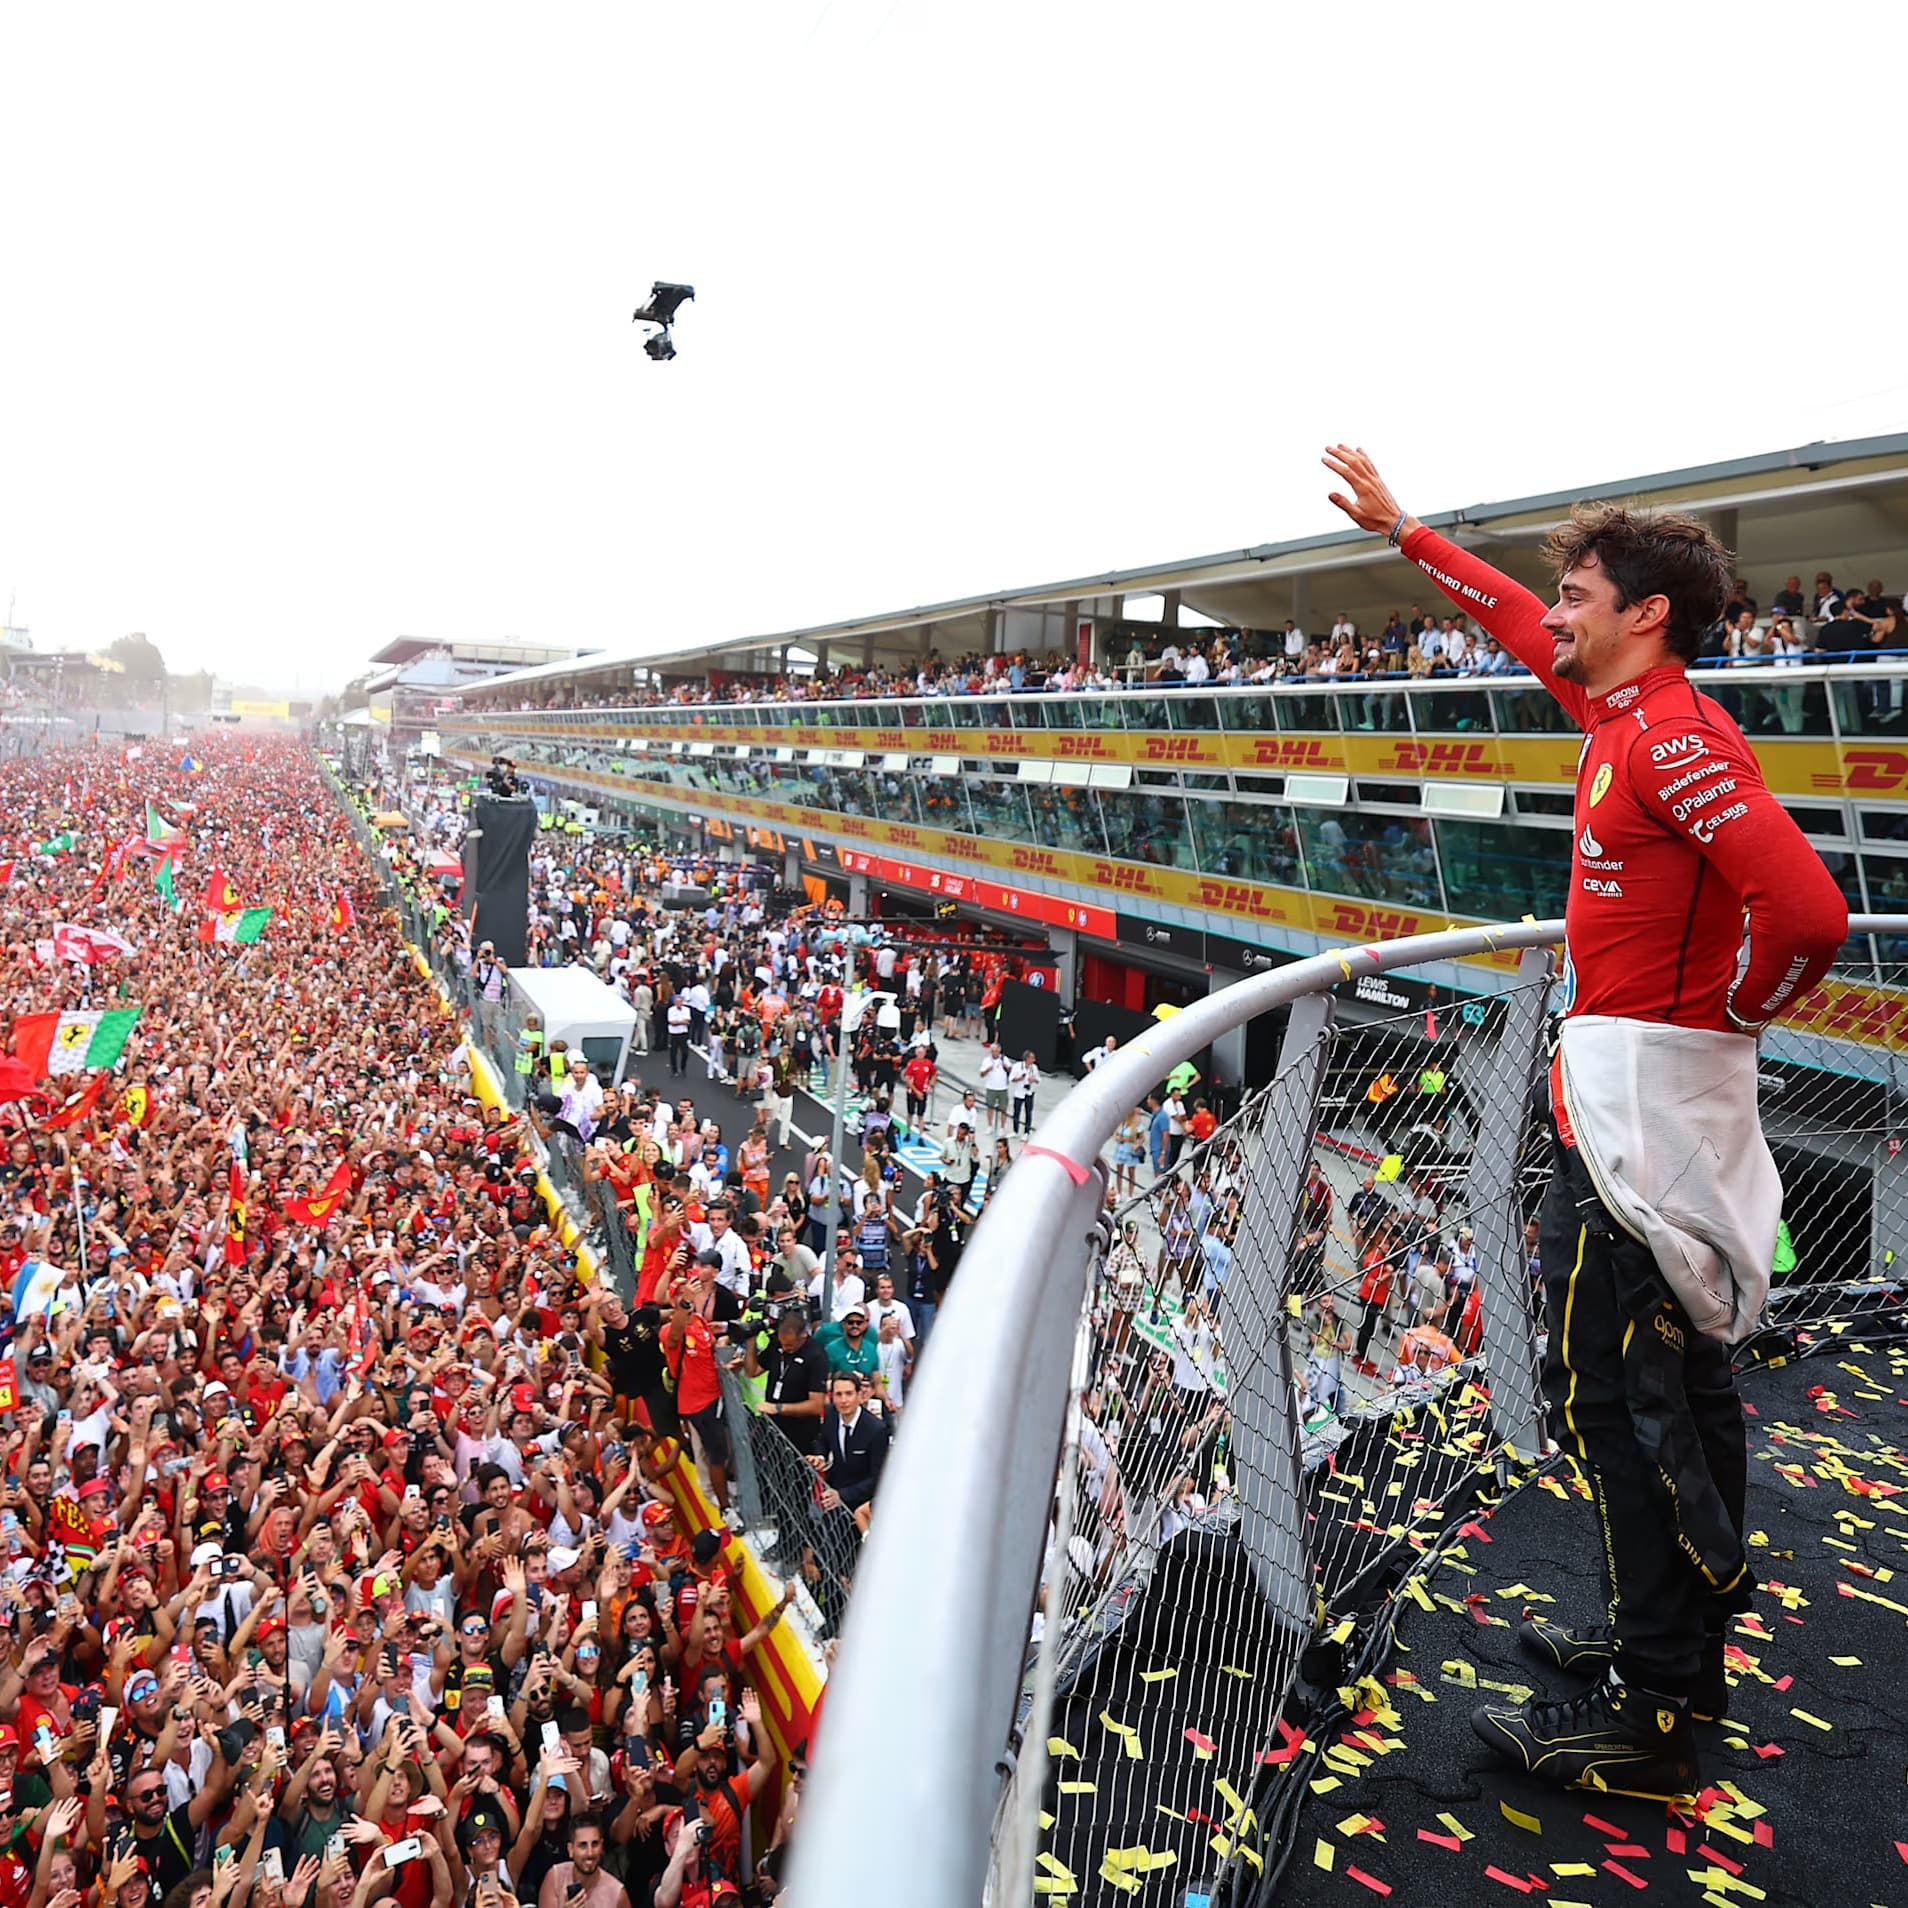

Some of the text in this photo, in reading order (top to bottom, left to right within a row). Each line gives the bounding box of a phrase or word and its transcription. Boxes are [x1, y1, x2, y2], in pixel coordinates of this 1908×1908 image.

[1418, 558, 1498, 609] RICHARD MILLE
[927, 733, 962, 750] DHL
[986, 733, 1029, 753] DHL
[1058, 736, 1106, 757] DHL
[1146, 738, 1204, 761] DHL
[1254, 739, 1330, 766] DHL
[1650, 734, 1704, 762] aws
[1394, 742, 1494, 773] DHL
[1658, 761, 1730, 801] Bitdefender
[1682, 778, 1737, 814] Palantir
[1706, 801, 1748, 831] CELSIUS
[888, 826, 921, 848] DHL
[944, 835, 984, 861] DHL
[1013, 848, 1058, 875] DHL
[1095, 862, 1153, 893] DHL
[1198, 881, 1271, 917] DHL
[1357, 976, 1389, 992] LEWIS
[1761, 955, 1809, 1012] RICHARD MILLE
[1355, 987, 1410, 1009] HAMILTON
